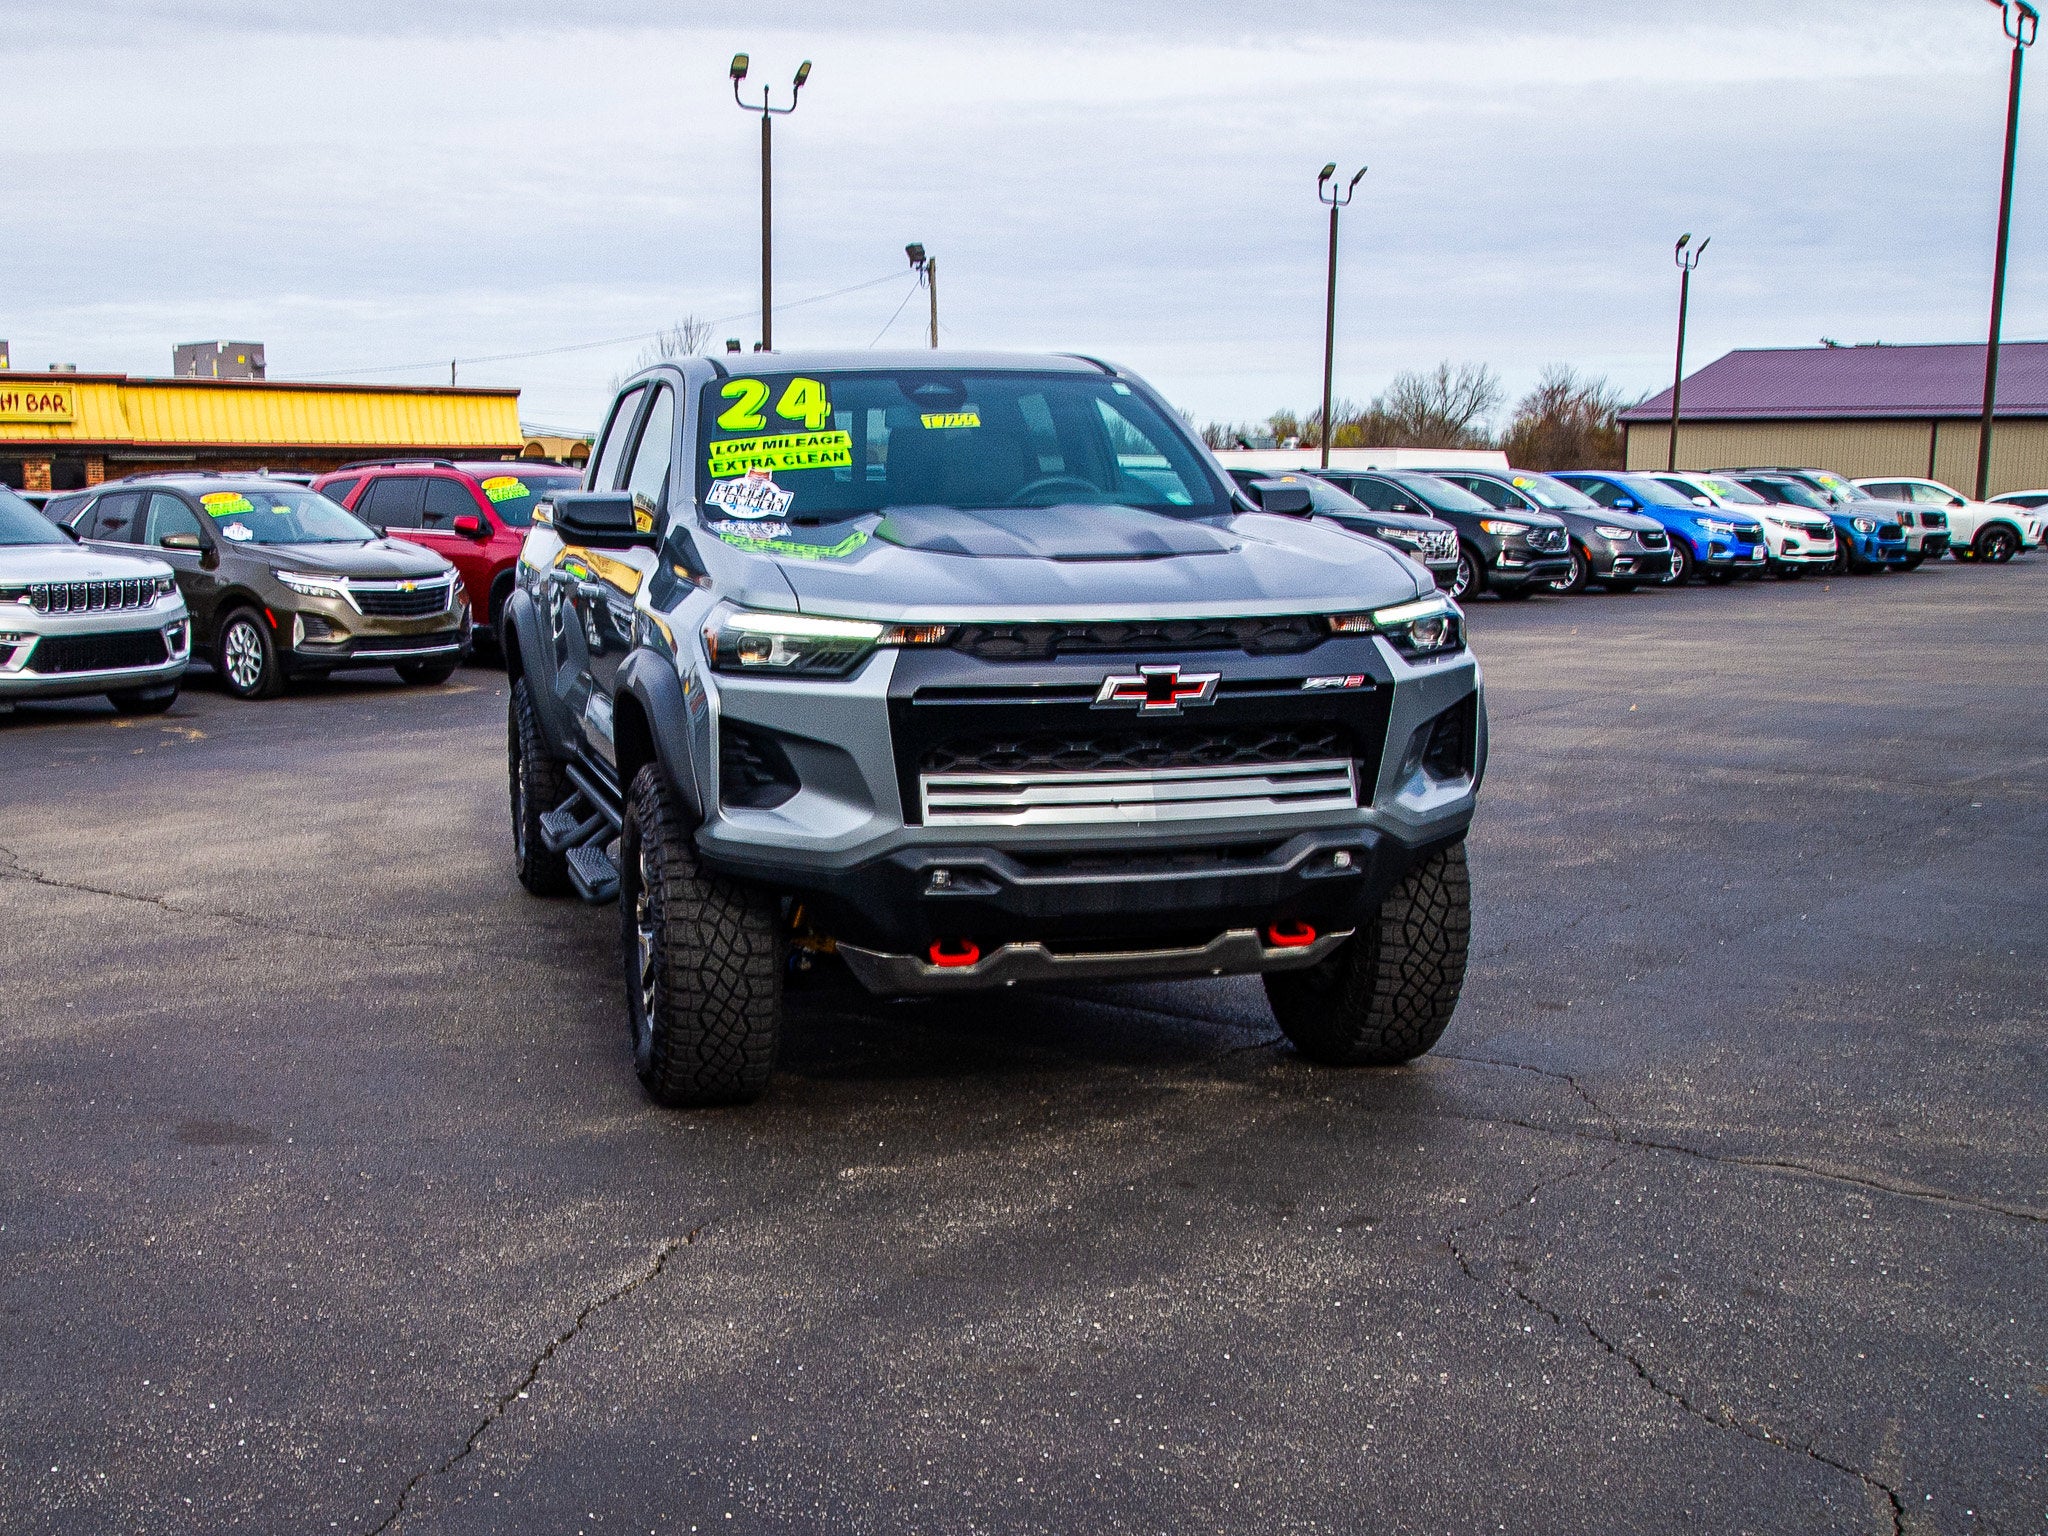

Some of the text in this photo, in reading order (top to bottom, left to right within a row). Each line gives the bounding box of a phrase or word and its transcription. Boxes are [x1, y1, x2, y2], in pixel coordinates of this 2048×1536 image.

[25, 393, 66, 413] BAR
[717, 377, 832, 431] 24
[715, 435, 845, 455] LOW MILEAGE
[713, 451, 844, 473] EXTRA CLEAN
